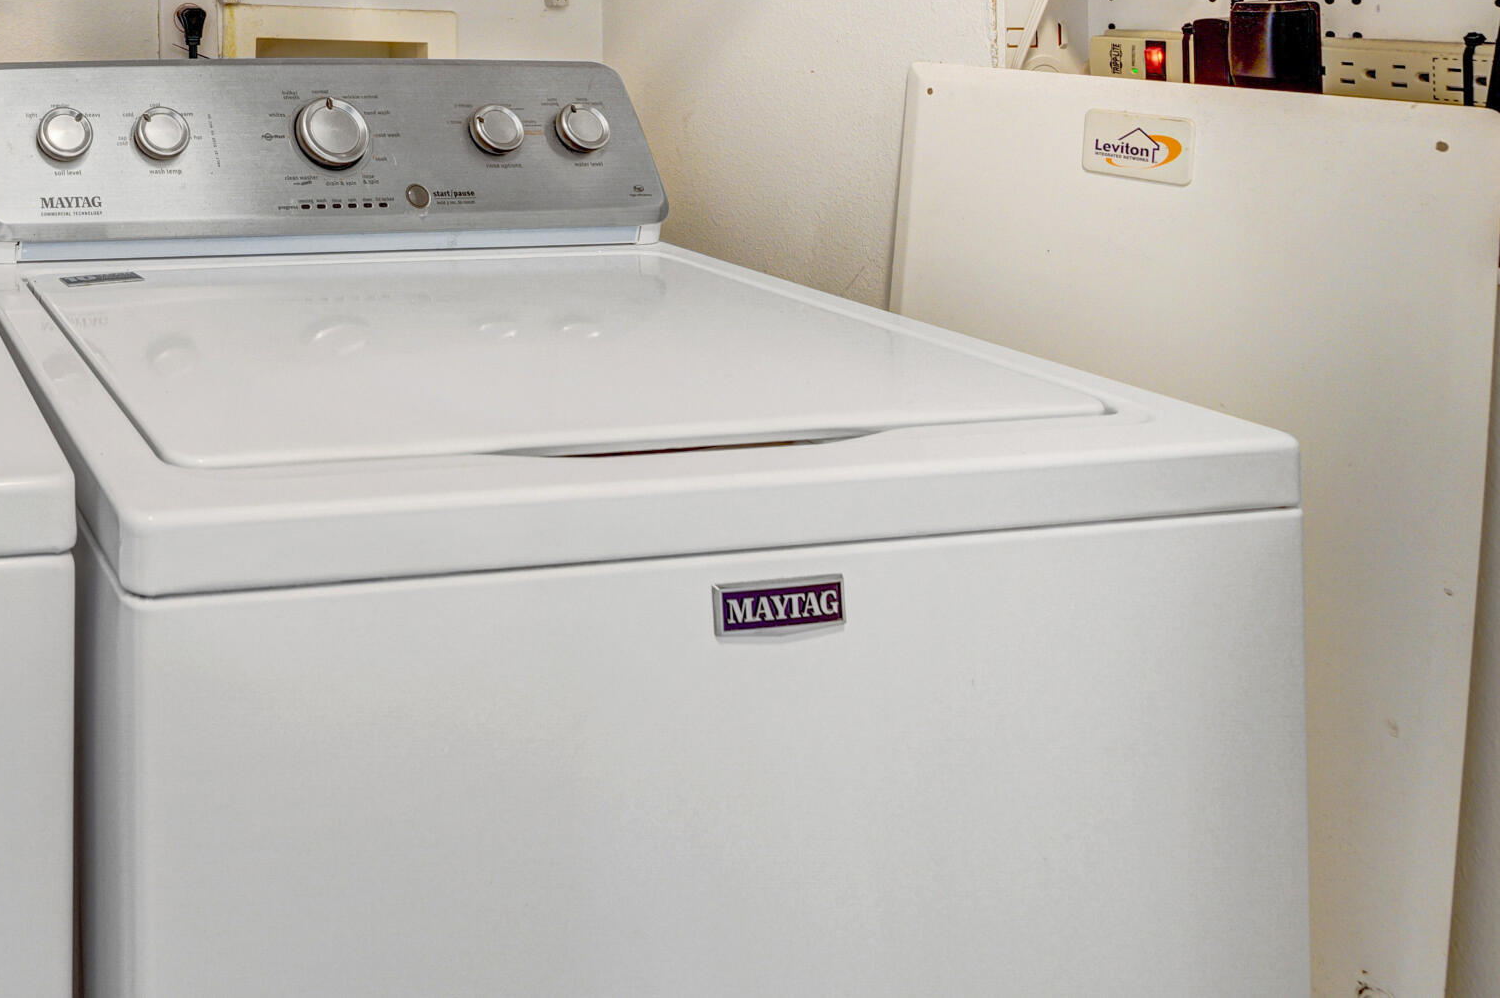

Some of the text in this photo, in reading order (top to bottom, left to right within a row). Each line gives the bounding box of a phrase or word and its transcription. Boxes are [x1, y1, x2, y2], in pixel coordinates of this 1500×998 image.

[1094, 138, 1150, 157] Leviton
[41, 196, 102, 210] MAYTAG
[726, 589, 839, 624] MAYTAG
